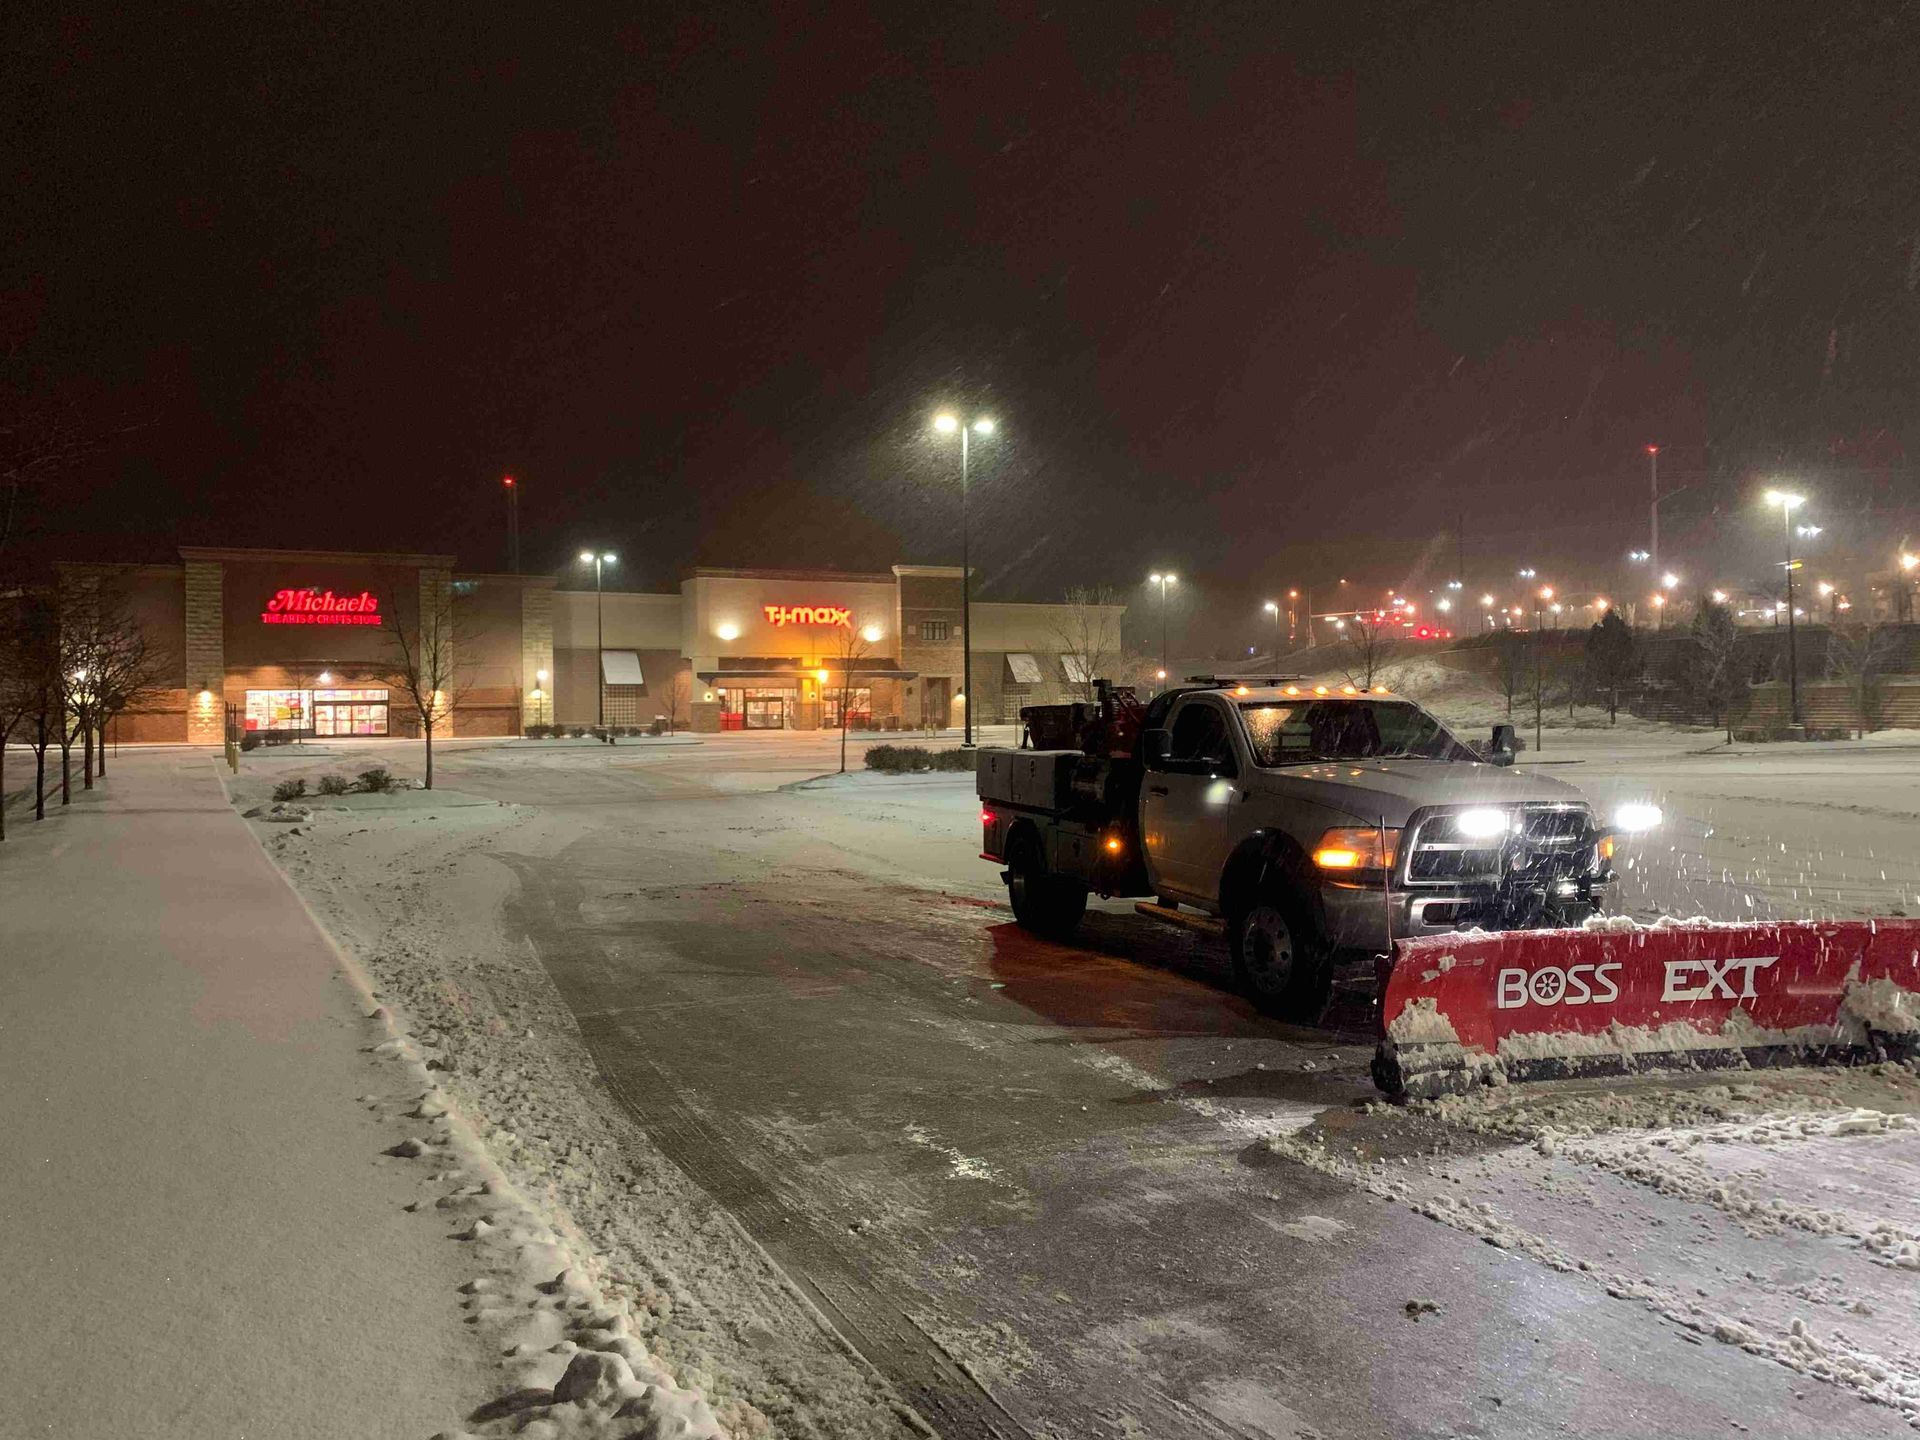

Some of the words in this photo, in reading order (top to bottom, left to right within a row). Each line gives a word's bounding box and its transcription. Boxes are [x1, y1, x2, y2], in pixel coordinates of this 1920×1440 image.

[268, 590, 378, 612] Michaels
[262, 613, 281, 624] THE
[282, 614, 306, 624] ARTS
[307, 614, 315, 624] &
[316, 614, 351, 625] CRAFTS
[353, 614, 382, 625] STORE
[1498, 962, 1623, 1009] BOSS
[1660, 956, 1780, 1002] EXT
